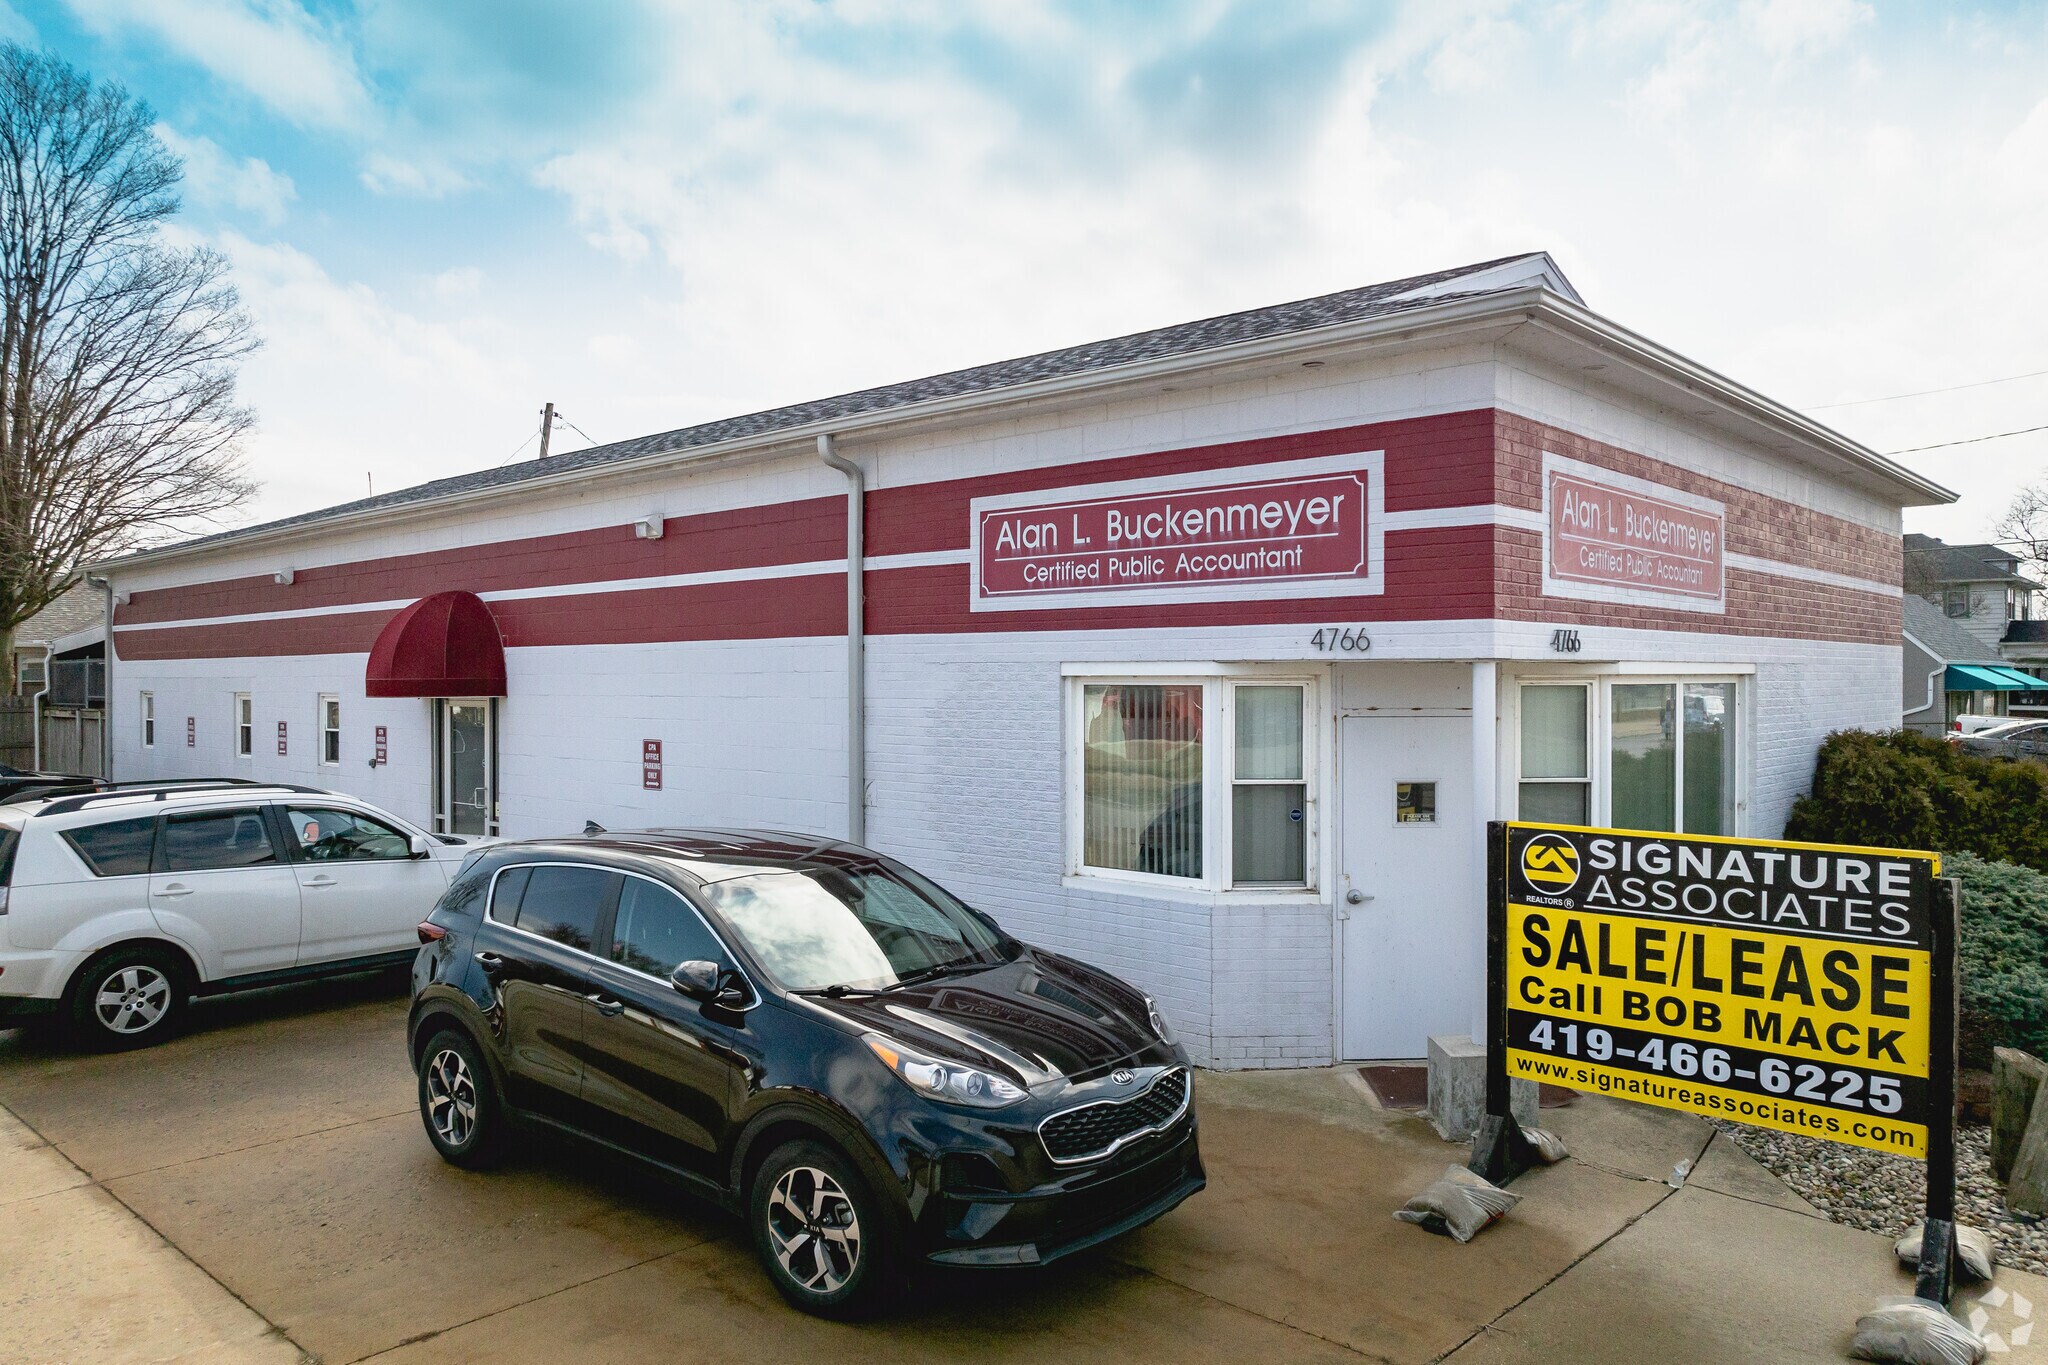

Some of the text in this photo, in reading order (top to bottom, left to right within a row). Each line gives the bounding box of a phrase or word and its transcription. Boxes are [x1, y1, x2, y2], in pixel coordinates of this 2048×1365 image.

[995, 494, 1344, 551] Alan L. Buckenmeyer
[1562, 489, 1716, 561] Alan L. Buckenmeyer
[1023, 544, 1303, 583] Certified Public Accountant
[1579, 545, 1703, 585] Certified Public Accountant
[1310, 627, 1371, 652] 4766
[1551, 629, 1581, 653] 4766
[1588, 839, 1910, 897] SIGNATURE
[1586, 875, 1911, 936] ASSOCIATES
[1522, 913, 1910, 1020] SALE/LEASE
[1519, 976, 1906, 1064] Call BOB MACK
[1114, 1070, 1133, 1083] KIA
[1529, 1019, 1903, 1114] 419-466-6225
[1516, 1056, 1914, 1149] www.signatureassociates.com
[810, 1225, 820, 1233] KIA
